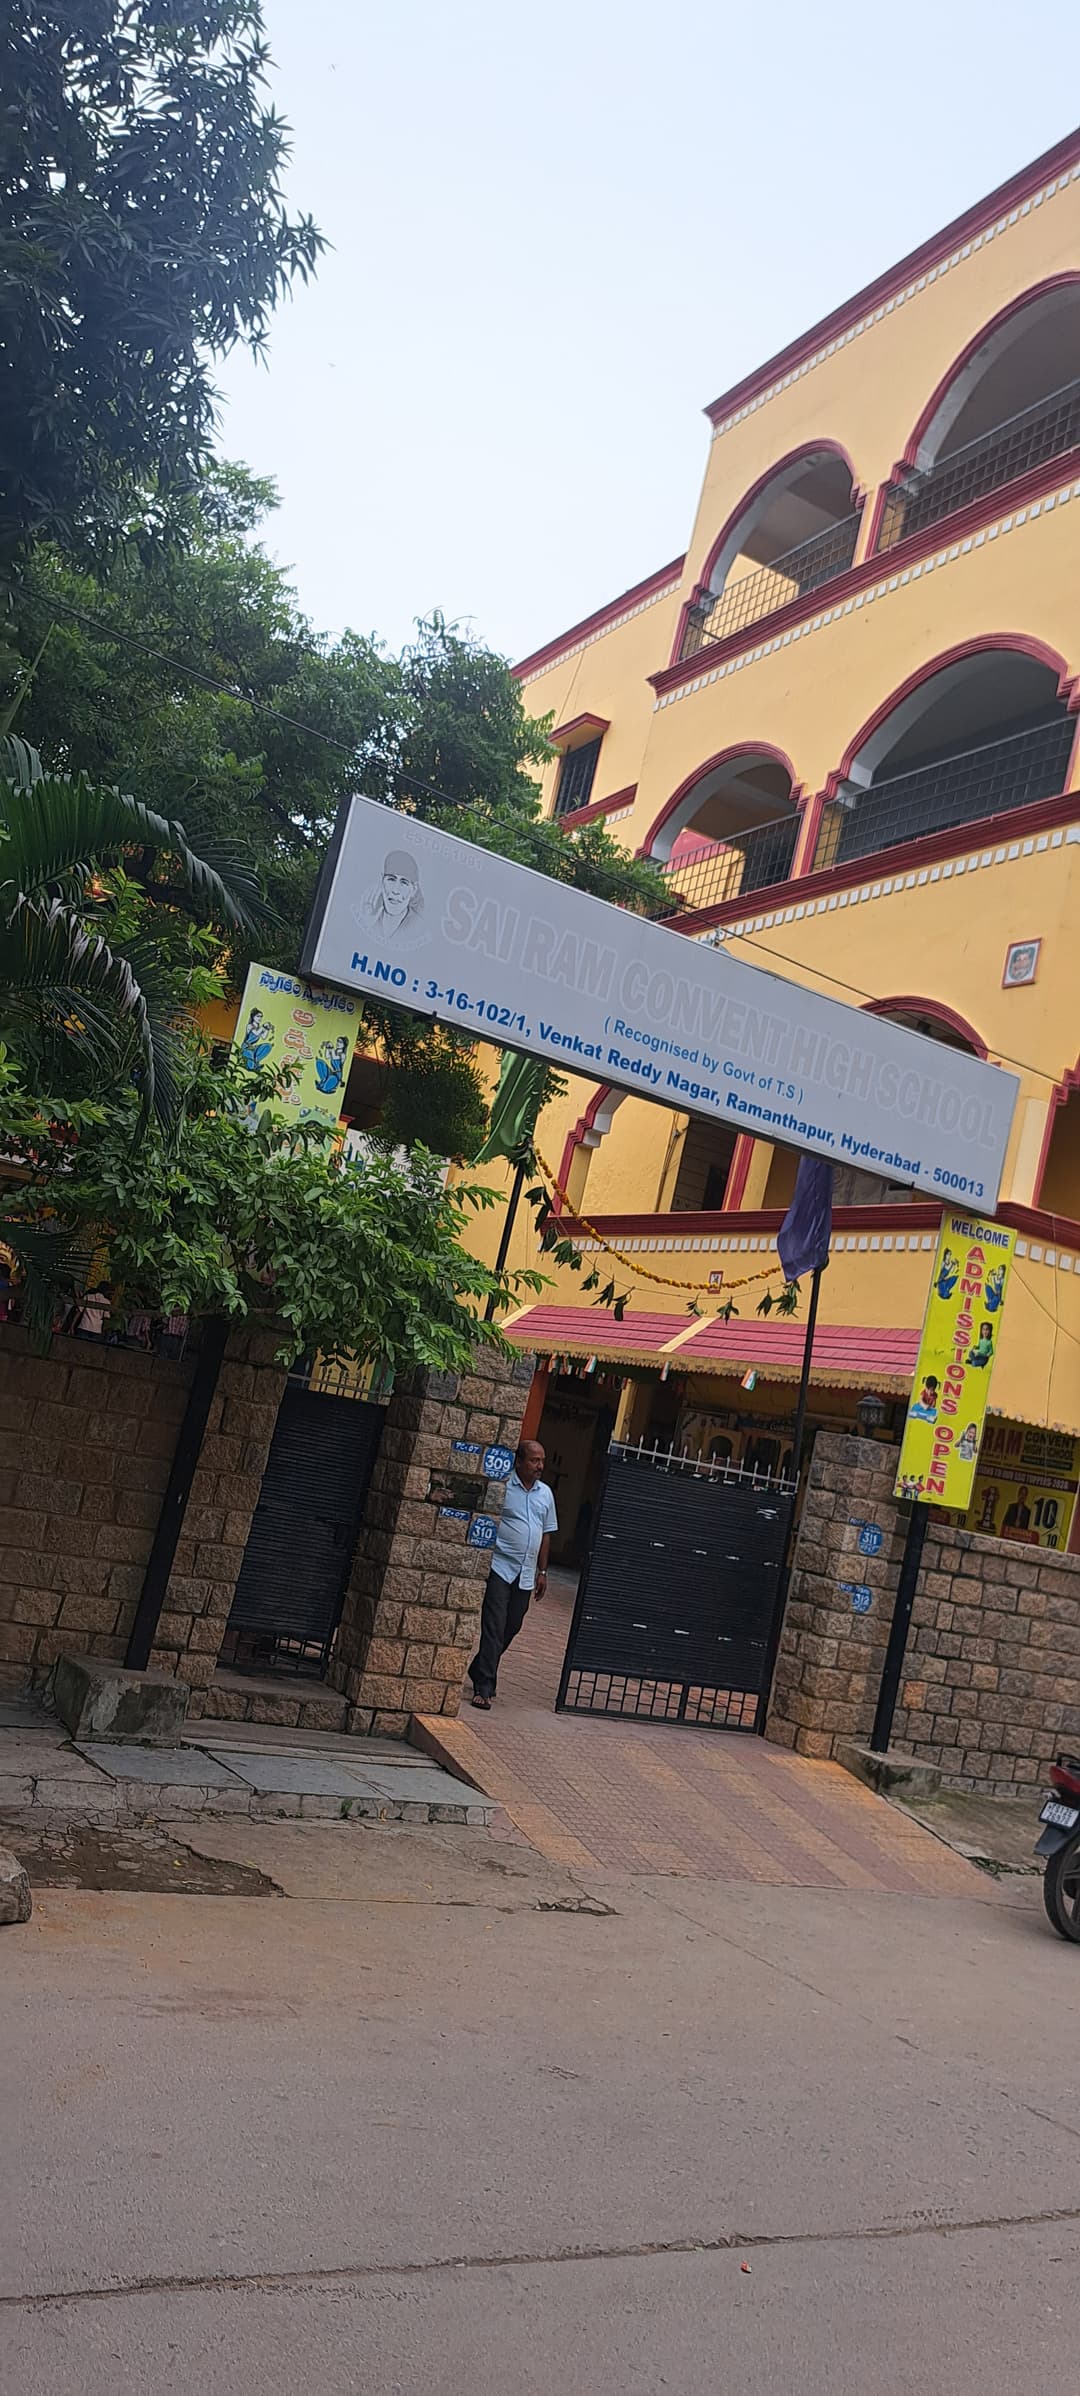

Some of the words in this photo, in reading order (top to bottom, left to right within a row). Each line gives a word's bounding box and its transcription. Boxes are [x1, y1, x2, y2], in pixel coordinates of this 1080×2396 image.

[442, 887, 520, 963] SAI
[520, 916, 618, 1001] RAM
[620, 960, 790, 1066] CONVENT
[788, 1024, 875, 1100] HIGH
[875, 1061, 997, 1148] SCHOOL
[614, 1019, 699, 1063] Recognised
[702, 1053, 719, 1074] by
[723, 1061, 756, 1085] Govt
[759, 1077, 773, 1090] of
[777, 1080, 796, 1099] T.S
[351, 952, 406, 986] H.NO
[425, 981, 530, 1037] 3-16-102/1,
[539, 1022, 603, 1060] Venkat
[607, 1048, 662, 1084] Reddy
[666, 1071, 720, 1105] Nagar,
[726, 1092, 835, 1147] Ramanthapur,
[840, 1133, 921, 1175] Hyderabad
[933, 1168, 984, 1197] 500013
[950, 1218, 1010, 1248] WELCOME
[940, 1245, 987, 1415] ADMISSIONS
[1025, 1430, 1076, 1446] CONVENT
[485, 1455, 511, 1472] 309
[925, 1426, 954, 1494] OPEN
[1034, 1498, 1058, 1529] 10
[473, 1526, 493, 1539] 310
[862, 1532, 878, 1545] 311
[1047, 1534, 1058, 1548] 10
[854, 1593, 870, 1604] 312
